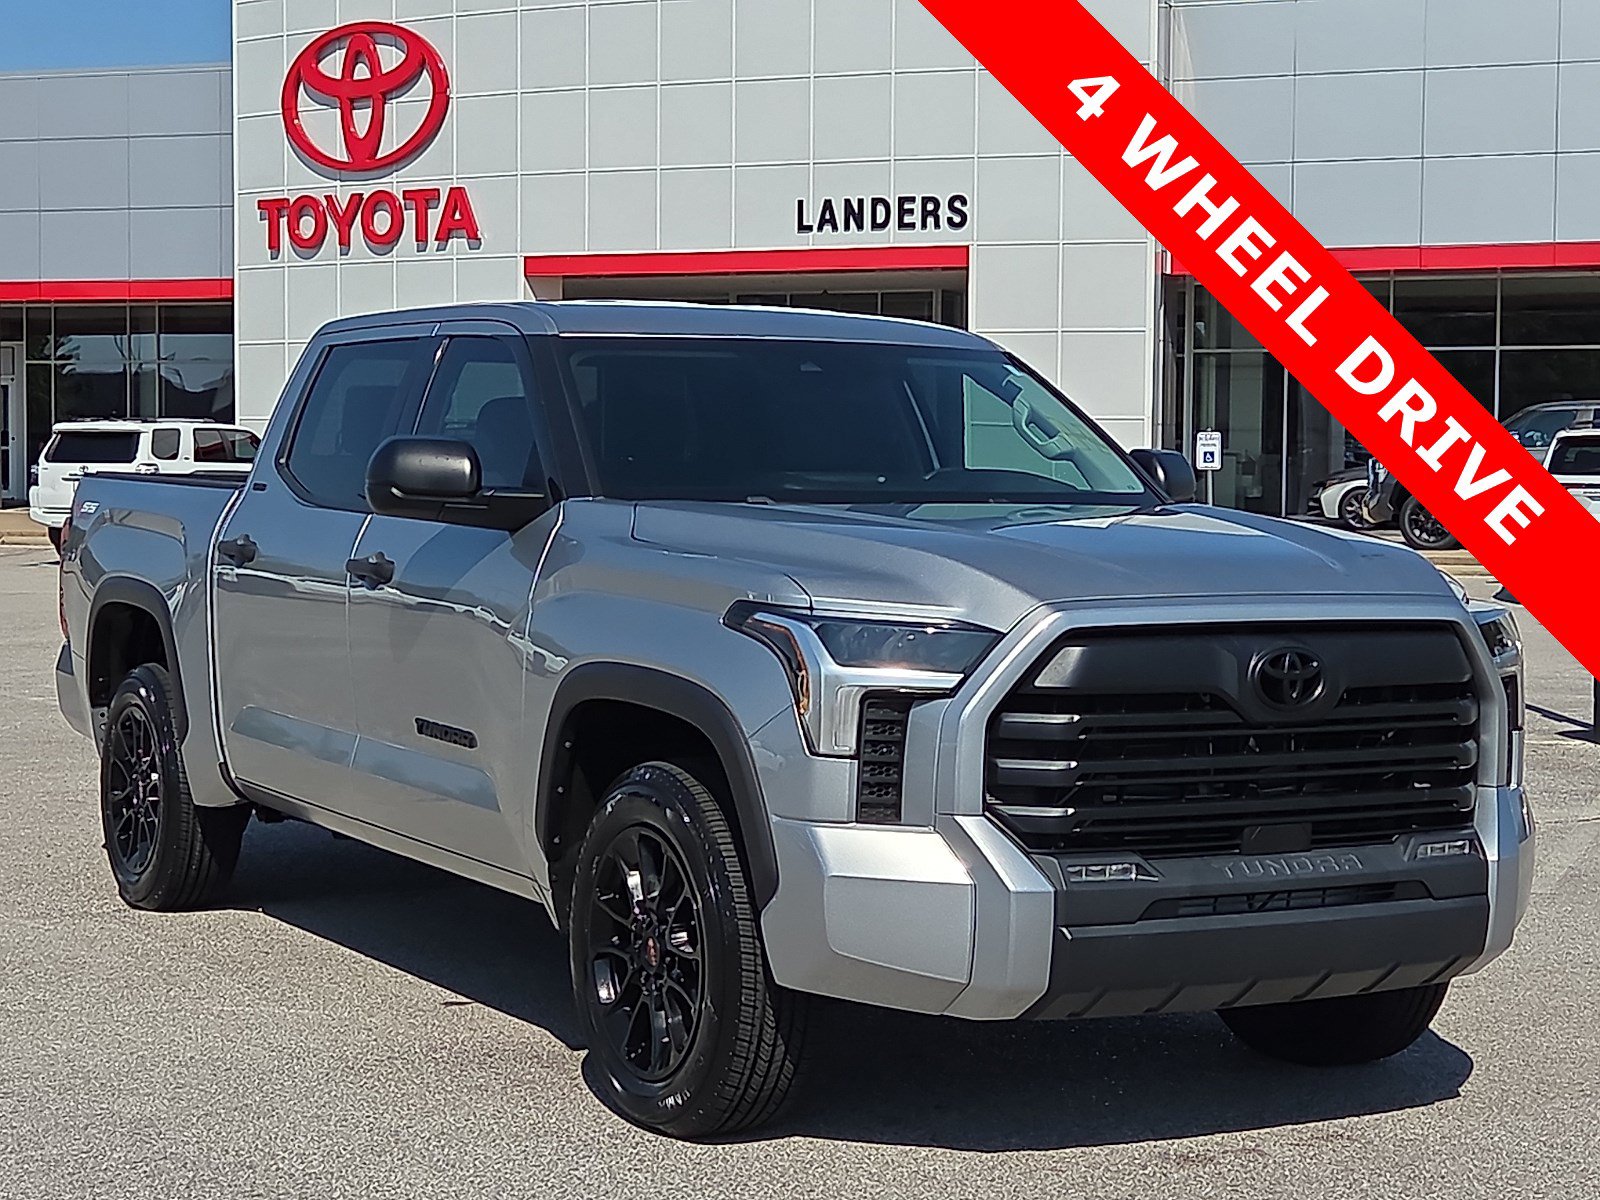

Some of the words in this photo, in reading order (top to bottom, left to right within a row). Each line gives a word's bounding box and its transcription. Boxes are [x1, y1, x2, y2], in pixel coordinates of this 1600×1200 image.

[257, 186, 482, 254] TOYOTA
[796, 194, 968, 233] LANDERS
[1210, 853, 1364, 880] TUNDRA
